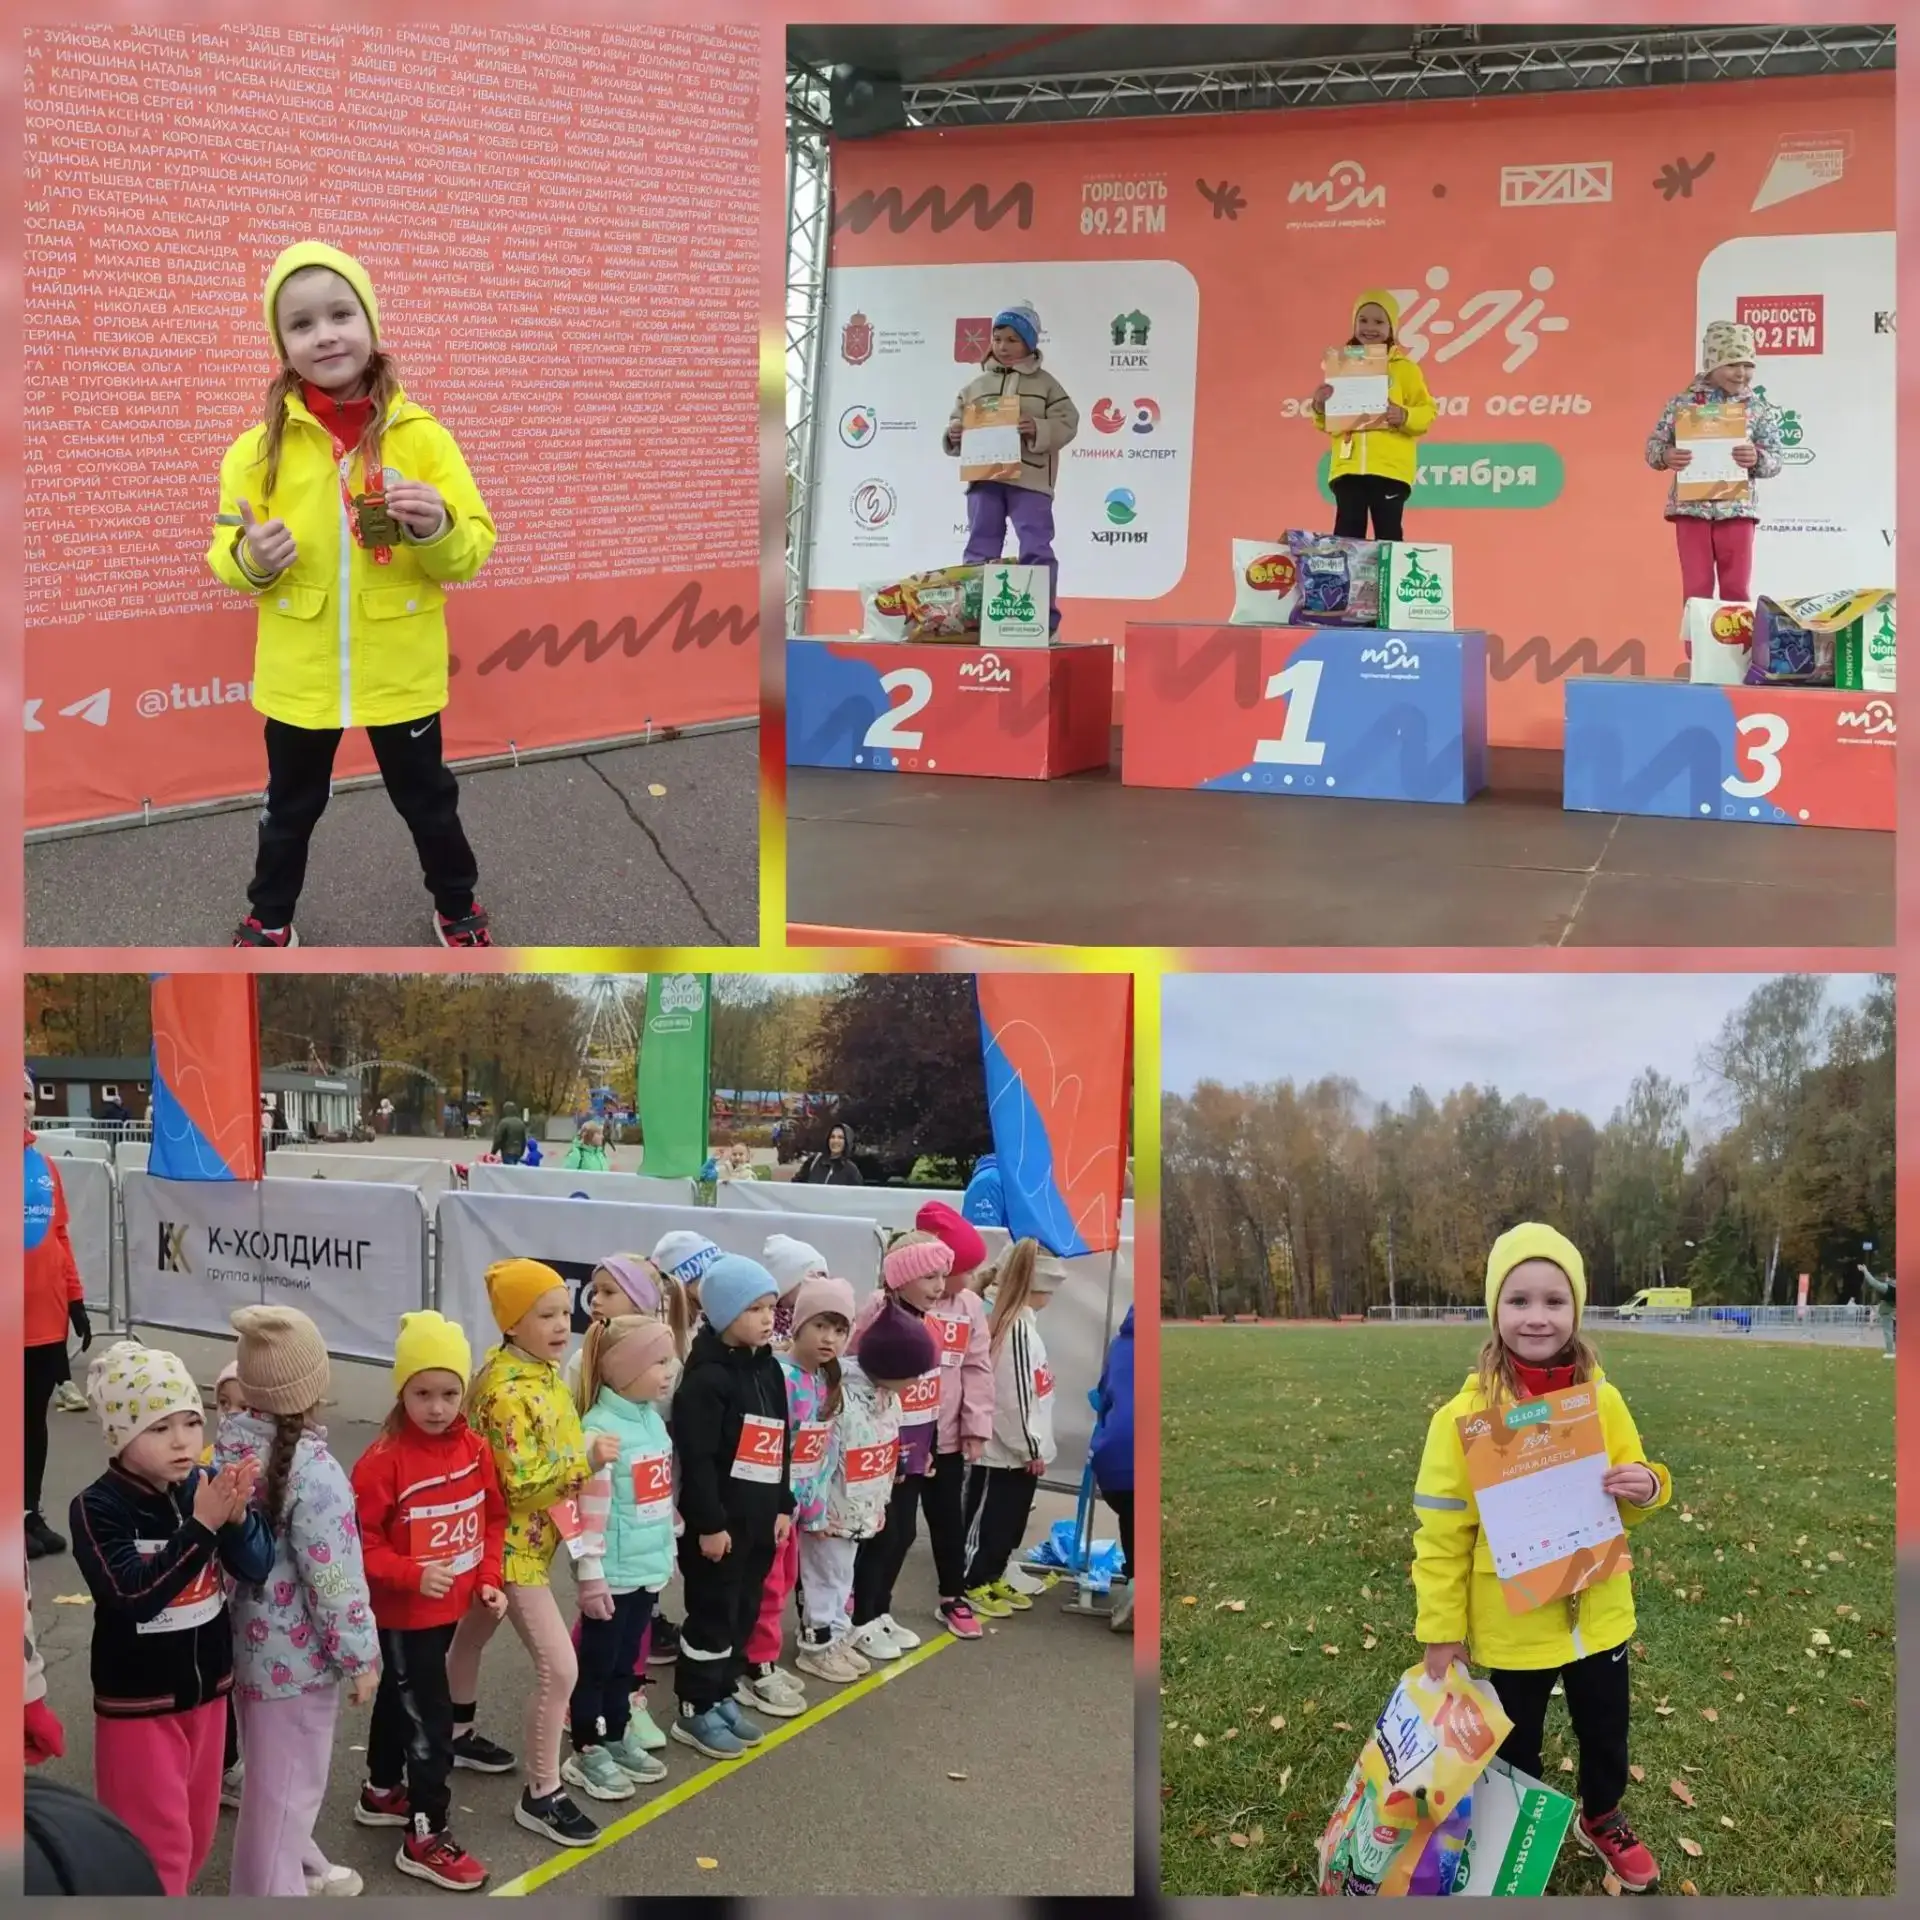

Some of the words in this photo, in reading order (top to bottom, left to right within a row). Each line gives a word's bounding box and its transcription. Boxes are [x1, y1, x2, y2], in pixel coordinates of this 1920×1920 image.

[44, 29, 111, 49] ЗУЙКОВА
[113, 40, 190, 60] КРИСТИНА
[199, 51, 281, 73] ИВАНИЦКИЙ
[131, 24, 185, 42] ЗАЙЦЕВ
[191, 32, 229, 48] ИВАН
[245, 40, 295, 58] ЗАЙЦЕВ
[301, 50, 336, 63] ИВАН
[56, 49, 137, 69] ИНЮШИНА
[141, 60, 202, 77] НАТАЛЬЯ
[214, 70, 266, 86] ИСАЕВА
[270, 77, 333, 95] НАДЕЖДА
[49, 83, 139, 105] КЛЕЙМЕНОВ
[143, 94, 194, 111] СЕРГЕЙ
[206, 102, 279, 121] КЛИМЕНКО
[51, 66, 138, 87] КАПРАЛОВА
[143, 77, 217, 96] СТЕФАНИЯ
[232, 89, 334, 112] КАРНАУШЕНКОВ
[338, 102, 408, 121] АЛЕКСАНДР
[24, 99, 106, 118] КОЛЯДИНА
[108, 107, 164, 124] КСЕНИЯ
[26, 116, 103, 135] КОРОЛЕВА
[106, 124, 152, 140] ОЛЬГА
[163, 131, 232, 148] КОРОЛЕВА
[235, 138, 301, 155] СВЕТЛАНА
[51, 135, 126, 154] КОЧЕТОВА
[129, 143, 208, 161] МАРГАРИТА
[220, 153, 272, 168] КОЧКИН
[275, 158, 317, 172] БОРИС
[54, 169, 143, 189] КУЛТЫШЕВА
[146, 178, 217, 194] СВЕТЛАНА
[103, 158, 151, 172] НЕЛЛИ
[164, 164, 238, 181] КУДРЯШОВ
[240, 171, 309, 187] АНАТОЛИЙ
[42, 185, 83, 199] ЛАПО
[88, 189, 168, 206] ЕКАТЕРИНА
[1082, 180, 1168, 202] ГОРДОСТЬ
[71, 204, 145, 221] ЛУКЬЯНОВ
[152, 212, 230, 226] АЛЕКСАНДР
[1080, 206, 1128, 235] 89.2
[1132, 205, 1166, 234] FM
[104, 222, 180, 239] МАЛАХОВА
[185, 228, 221, 241] ЛИЛЯ
[89, 237, 150, 253] МАТЮХО
[154, 242, 239, 258] АЛЕКСАНДРА
[95, 254, 160, 269] МИХАЛЕВ
[167, 258, 246, 273] ВЛАДИСЛАВ
[83, 269, 163, 284] МУЖИЧКОВ
[167, 273, 247, 288] ВЛАДИСЛАВ
[32, 281, 103, 297] НАЙДИНА
[108, 286, 176, 300] НАДЕЖДА
[94, 301, 167, 315] НИКОЛАЕВ
[172, 304, 247, 318] АЛЕКСАНДР
[1744, 308, 1817, 324] ГОРДОСТЬ
[93, 316, 149, 329] ОРЛОВА
[151, 317, 219, 331] АНГЕЛИНА
[93, 331, 154, 343] ПЕЗИКОВ
[160, 331, 217, 345] АЛЕКСЕЙ
[1752, 327, 1783, 348] 9.2
[1786, 326, 1815, 347] FM
[64, 345, 120, 358] ПИНЧУК
[122, 345, 197, 360] ВЛАДИМИР
[1110, 355, 1149, 367] ПАРК
[62, 361, 135, 373] ПОЛЯКОВА
[141, 361, 183, 373] ОЛЬГА
[79, 375, 158, 388] ПУГОВКИНА
[160, 376, 227, 388] АНГЕЛИНА
[61, 390, 145, 403] РОДИОНОВА
[151, 390, 182, 401] ВЕРА
[1485, 392, 1593, 416] осень
[73, 405, 120, 417] РЫСЕВ
[126, 404, 179, 416] КИРИЛЛ
[101, 418, 192, 431] САМОФАЛОВА
[194, 419, 234, 430] ДАРЬЯ
[62, 434, 126, 446] СЕНЬКИН
[130, 433, 165, 444] ИЛЬЯ
[57, 448, 132, 460] СИМОНОВА
[136, 447, 181, 458] ИРИНА
[1071, 449, 1124, 459] КЛИНИКА
[1127, 449, 1178, 459] ЭКСПЕРТ
[77, 461, 146, 474] СОЛУКОВА
[150, 460, 200, 471] ТАМАРА
[1415, 458, 1537, 493] ктября
[31, 475, 101, 489] ГРИГОРИЙ
[112, 474, 186, 487] СТРОГАНОВ
[86, 489, 165, 501] ТАЛТЫКИНА
[166, 487, 189, 497] ТАЯ
[66, 504, 132, 516] ТЕРЕХОВА
[136, 501, 209, 513] АНАСТАСИЯ
[88, 516, 150, 529] ТУЖИКОВ
[154, 514, 185, 526] ОЛЕГ
[52, 532, 107, 545] ФЕДИНА
[111, 530, 144, 541] КИРА
[103, 555, 181, 569] ЦВЕТЫНИНА
[75, 568, 150, 582] ЧИСТЯКОВА
[153, 566, 201, 578] УЛЬЯНА
[75, 583, 138, 596] ШАЛАГИН
[142, 580, 186, 592] РОМАН
[1398, 584, 1442, 598] bionova
[60, 598, 117, 611] ШИПКОВ
[121, 595, 144, 606] ЛЕВ
[989, 602, 1035, 616] bionova
[95, 607, 157, 621] ЩЕРБИНА
[136, 677, 256, 718] @tula
[863, 668, 933, 750] 2
[1253, 660, 1326, 765] 1
[1721, 713, 1790, 799] 3
[208, 1226, 371, 1271] К-ХОЛДИНГ
[206, 1267, 250, 1284] группа
[251, 1273, 312, 1291] компаний
[905, 1381, 937, 1403] 260
[860, 1447, 893, 1471] 232
[430, 1512, 479, 1548] 249
[314, 1562, 344, 1588] STAY
[324, 1578, 353, 1598] COOL
